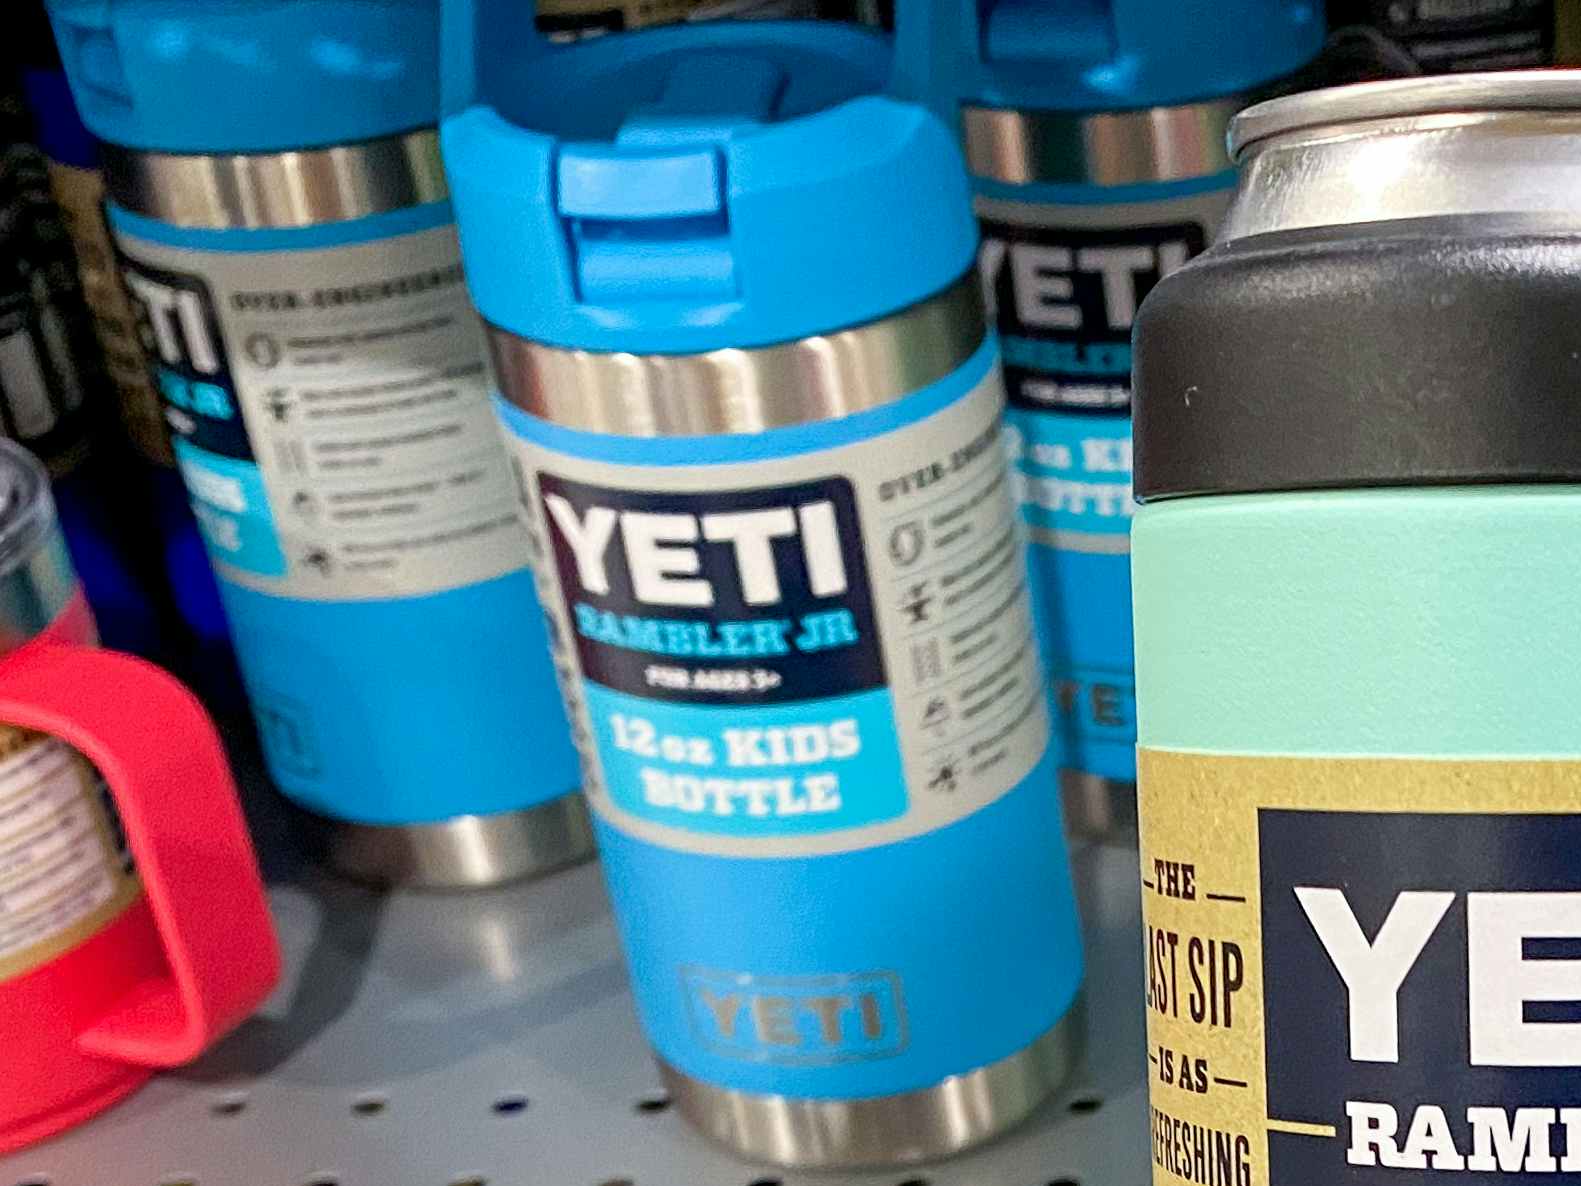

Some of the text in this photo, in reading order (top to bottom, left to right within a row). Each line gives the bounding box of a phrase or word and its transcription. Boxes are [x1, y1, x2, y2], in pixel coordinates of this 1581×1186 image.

[544, 494, 849, 608] YETI
[796, 608, 859, 652] JR
[722, 718, 861, 768] KIDS
[640, 764, 843, 816] BOTTLE
[1154, 858, 1197, 901] THE
[1189, 937, 1244, 1029] SIP
[699, 988, 883, 1045] YETI
[1158, 1046, 1209, 1093] IS AS
